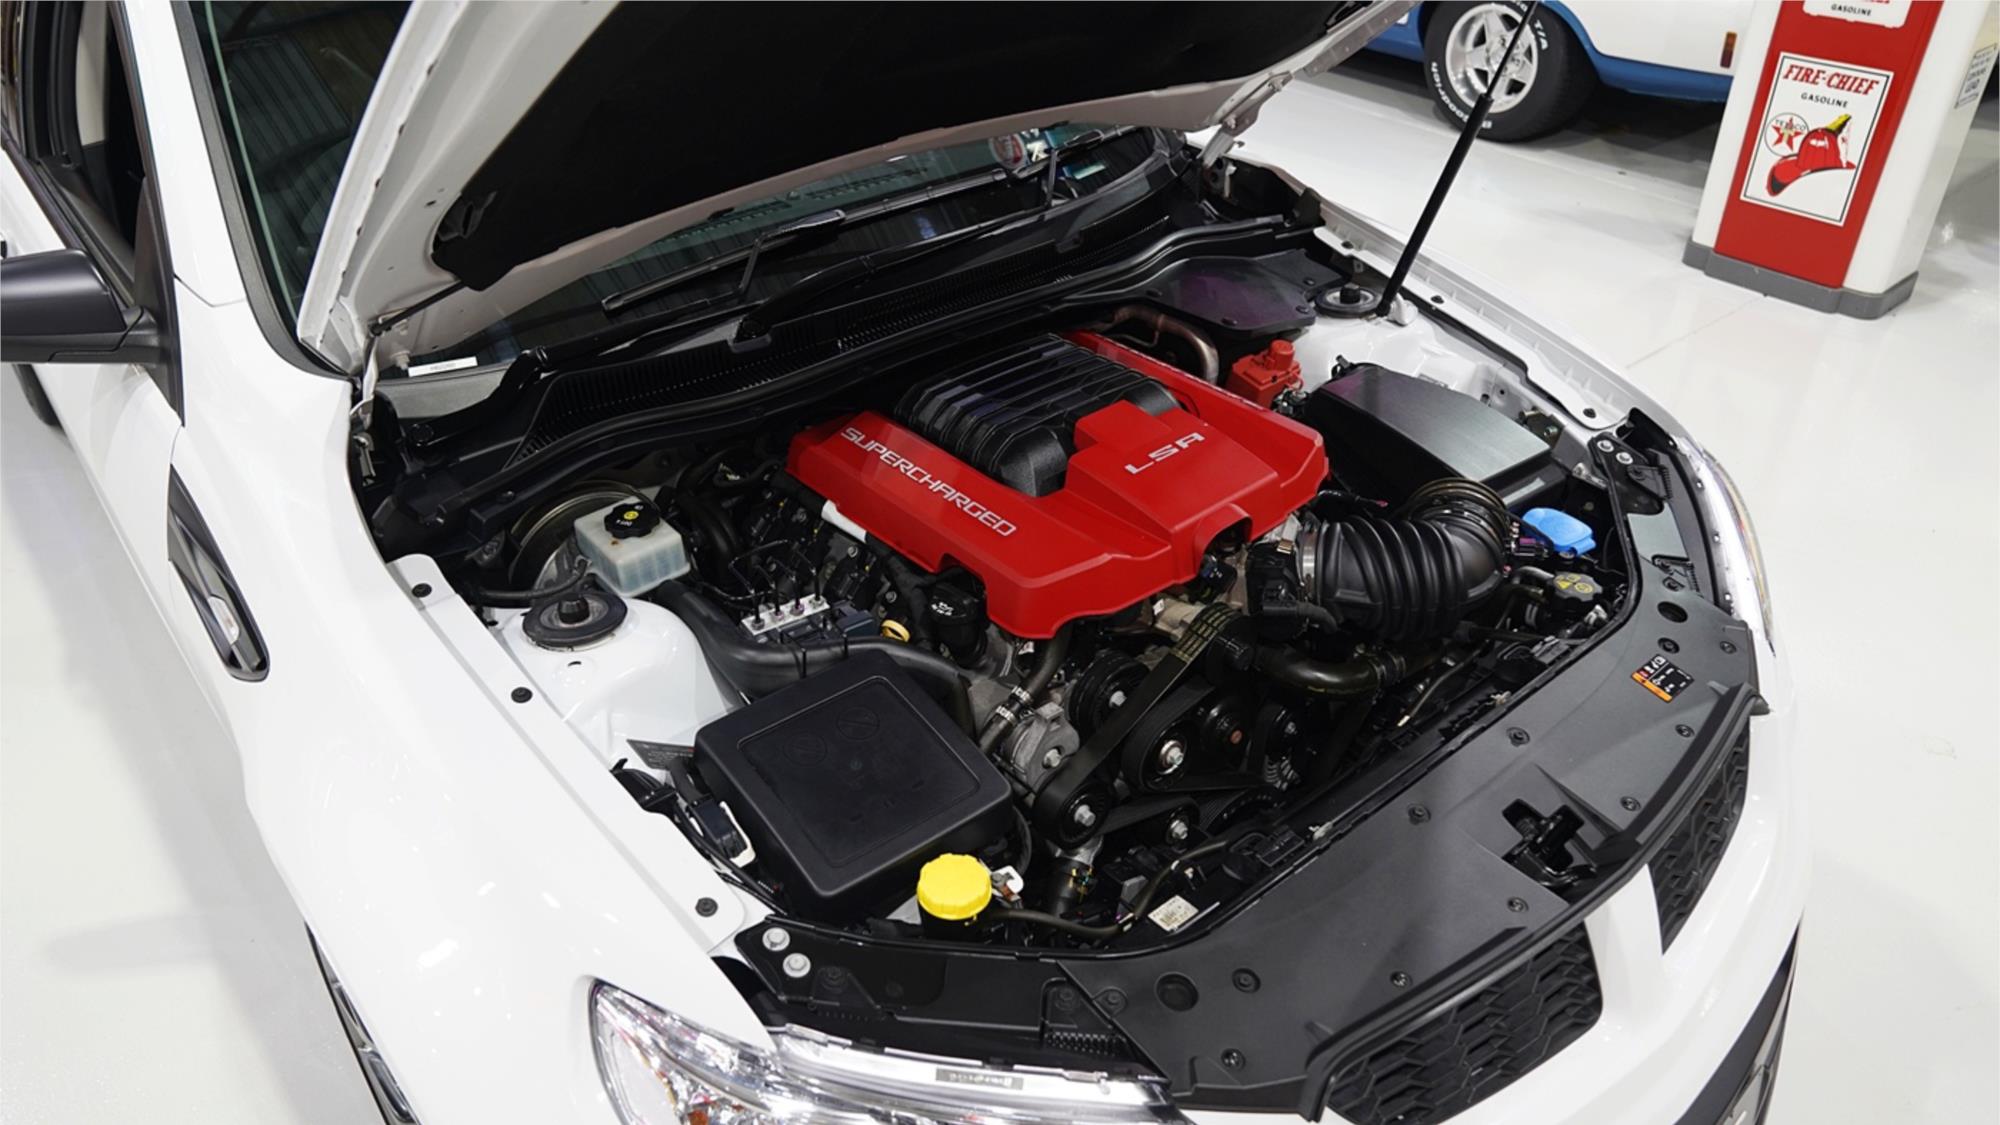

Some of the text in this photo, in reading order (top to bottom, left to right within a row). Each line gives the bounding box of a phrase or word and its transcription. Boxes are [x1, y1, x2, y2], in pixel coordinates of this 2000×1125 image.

[1831, 3, 1872, 17] GASOLINE
[1534, 19, 1549, 50] T/A
[1431, 61, 1493, 129] Boodrich
[1783, 64, 1880, 95] FIRE-CHIEF
[1801, 92, 1849, 109] GASOLINE
[1124, 432, 1206, 475] LSA
[841, 427, 1017, 537] SUPERCHARGED
